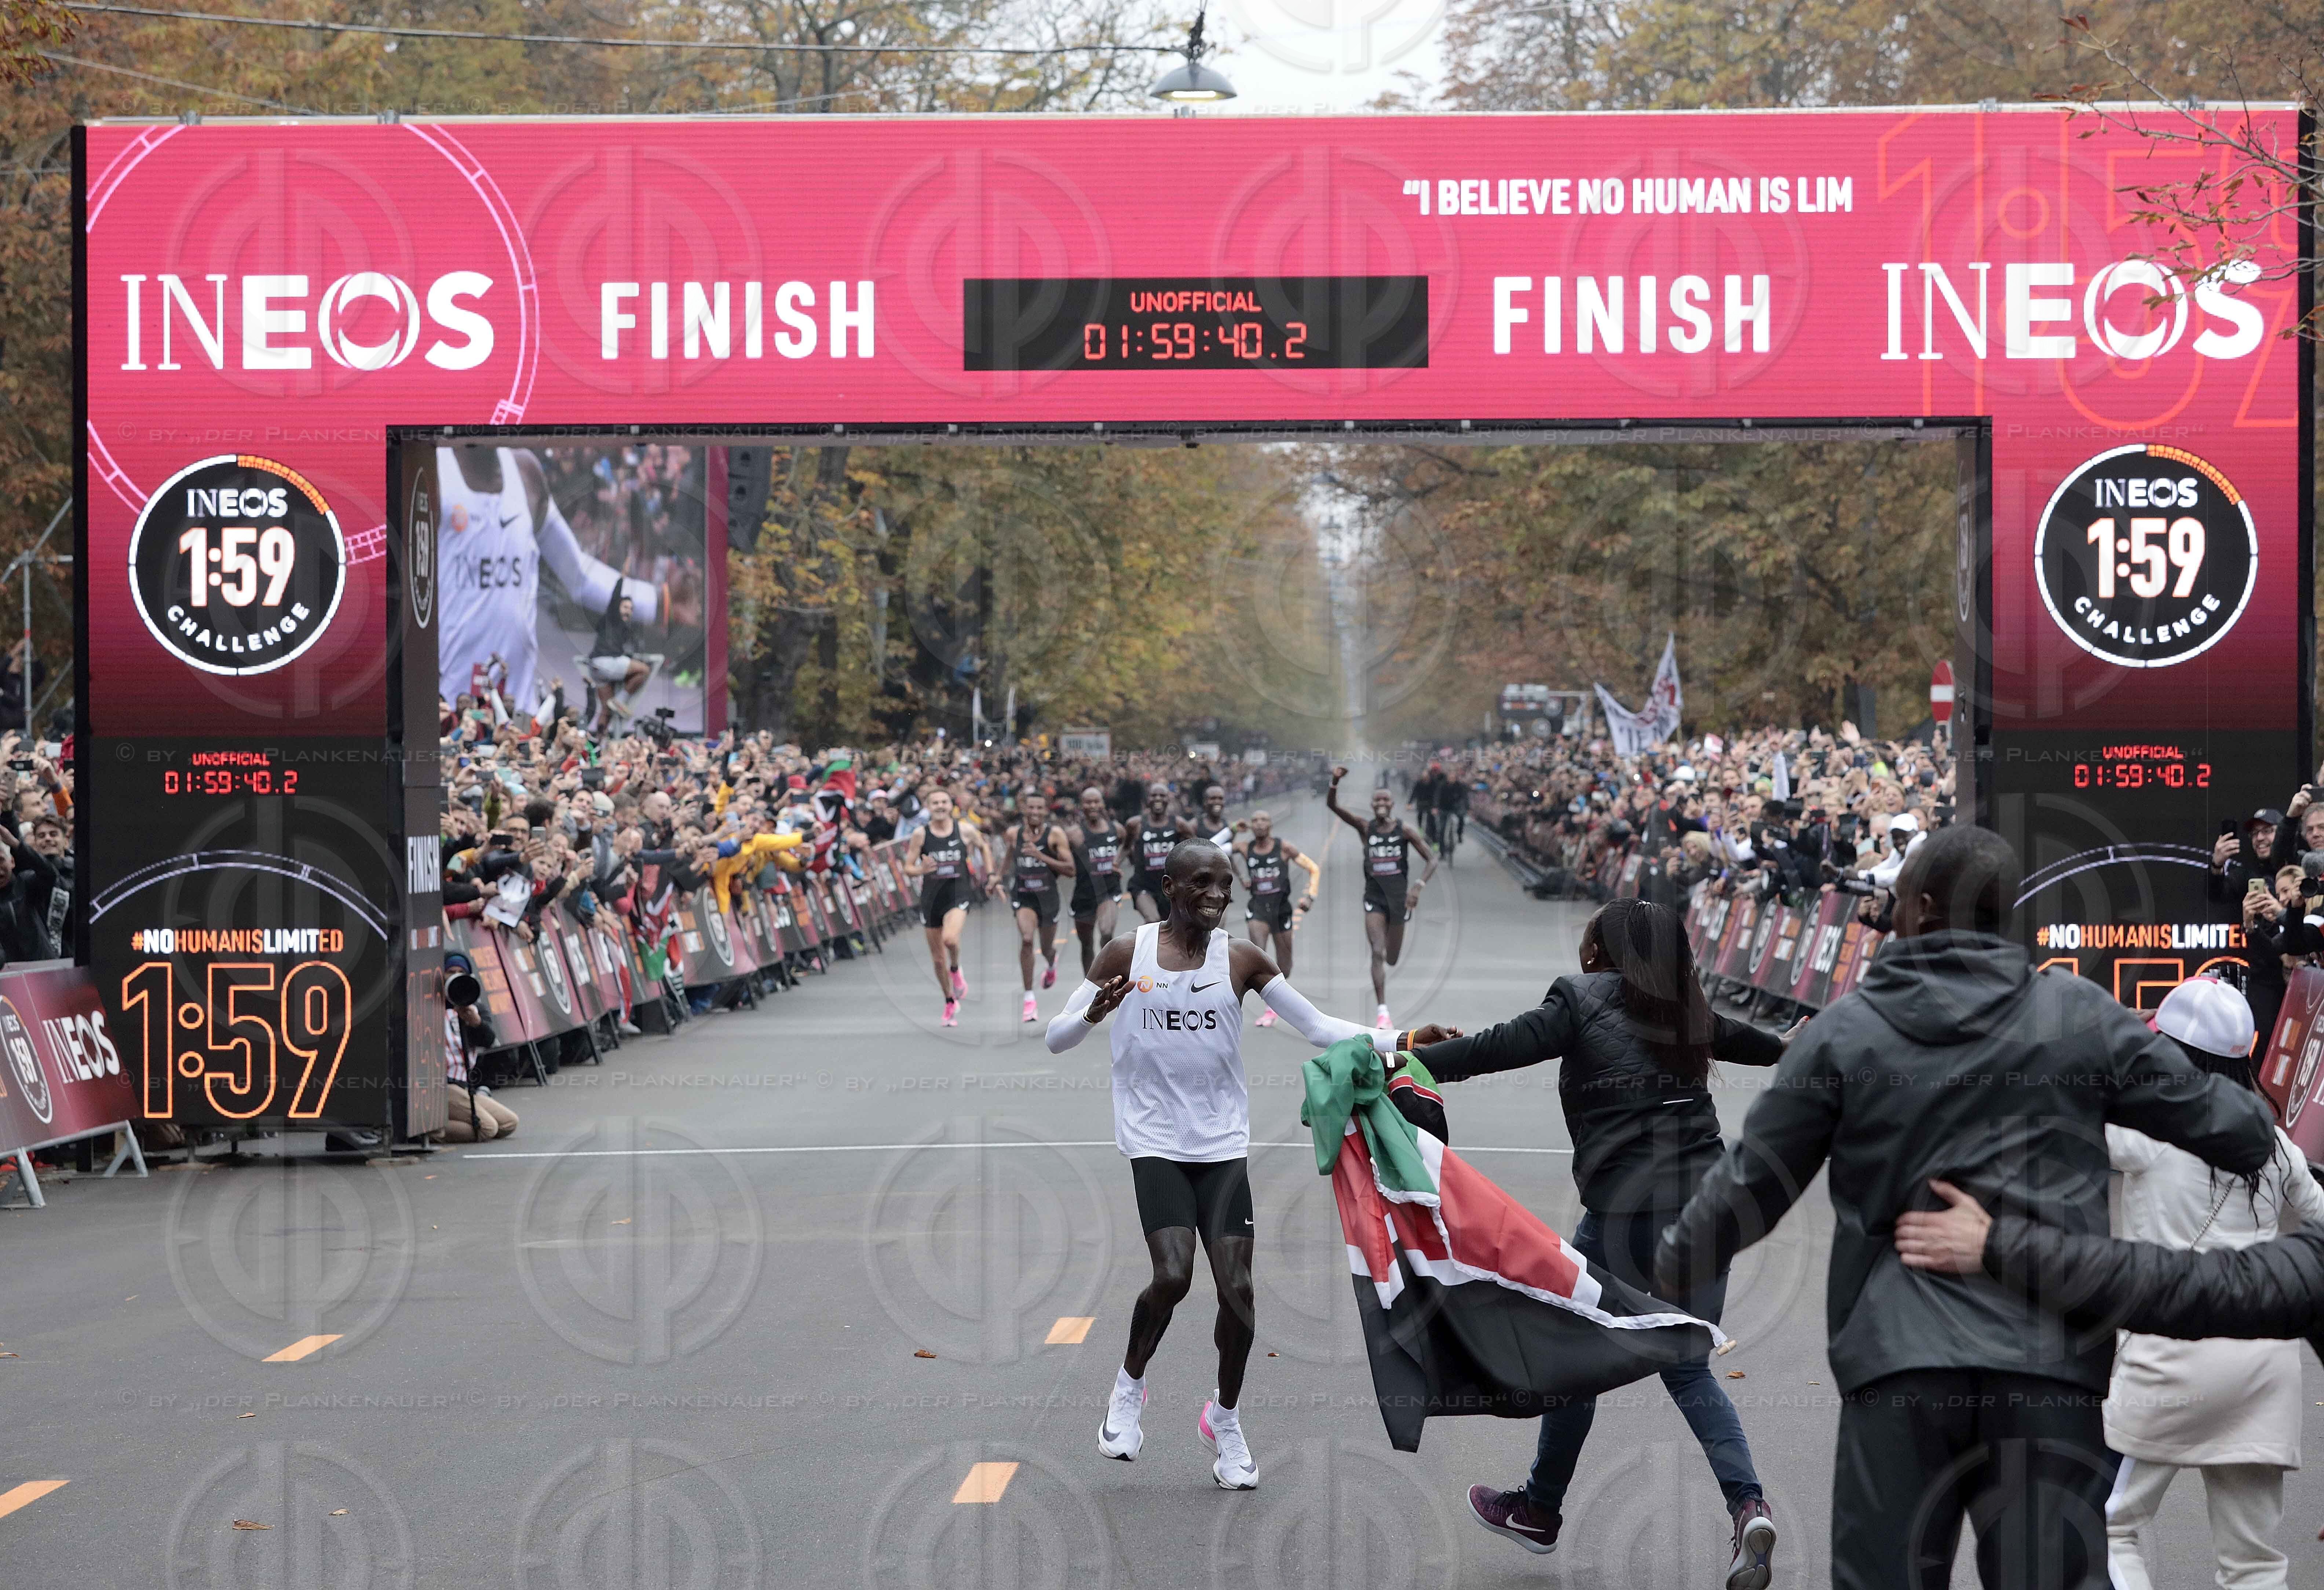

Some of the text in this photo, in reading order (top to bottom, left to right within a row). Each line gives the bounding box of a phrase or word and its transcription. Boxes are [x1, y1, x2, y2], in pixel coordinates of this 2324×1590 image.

[1438, 179, 1571, 215] BELIEVE
[1578, 178, 1625, 214] NO
[1633, 177, 1752, 214] HUMAN
[1760, 177, 1791, 213] IS
[1797, 176, 1853, 213] LIM
[121, 271, 494, 371] INEOS
[601, 281, 874, 359] FINISH
[1130, 290, 1262, 313] UNOFFICIAL
[1494, 275, 1770, 354] FINISH
[1880, 258, 2264, 360] INEOS
[1084, 322, 1307, 360] 01:59:40.2
[187, 488, 288, 518] INEOS
[2095, 477, 2198, 508] INEOS
[179, 527, 295, 607] 1:59
[2087, 517, 2205, 598] 1:59
[167, 602, 310, 653] CHALLENGE
[2075, 593, 2220, 645] CHALLENGE
[192, 752, 271, 767] UNOFFICIAL
[2102, 744, 2184, 760] UNOFFICIAL
[164, 770, 298, 794] 01:59:40.2
[2074, 763, 2212, 788] 01:59:40.2
[407, 835, 440, 894] FINISH
[131, 928, 344, 954] #NOHUMANISLIMITED
[122, 961, 351, 1118] 1:59
[1143, 1008, 1216, 1031] INEOS
[41, 1010, 120, 1084] INEOS
